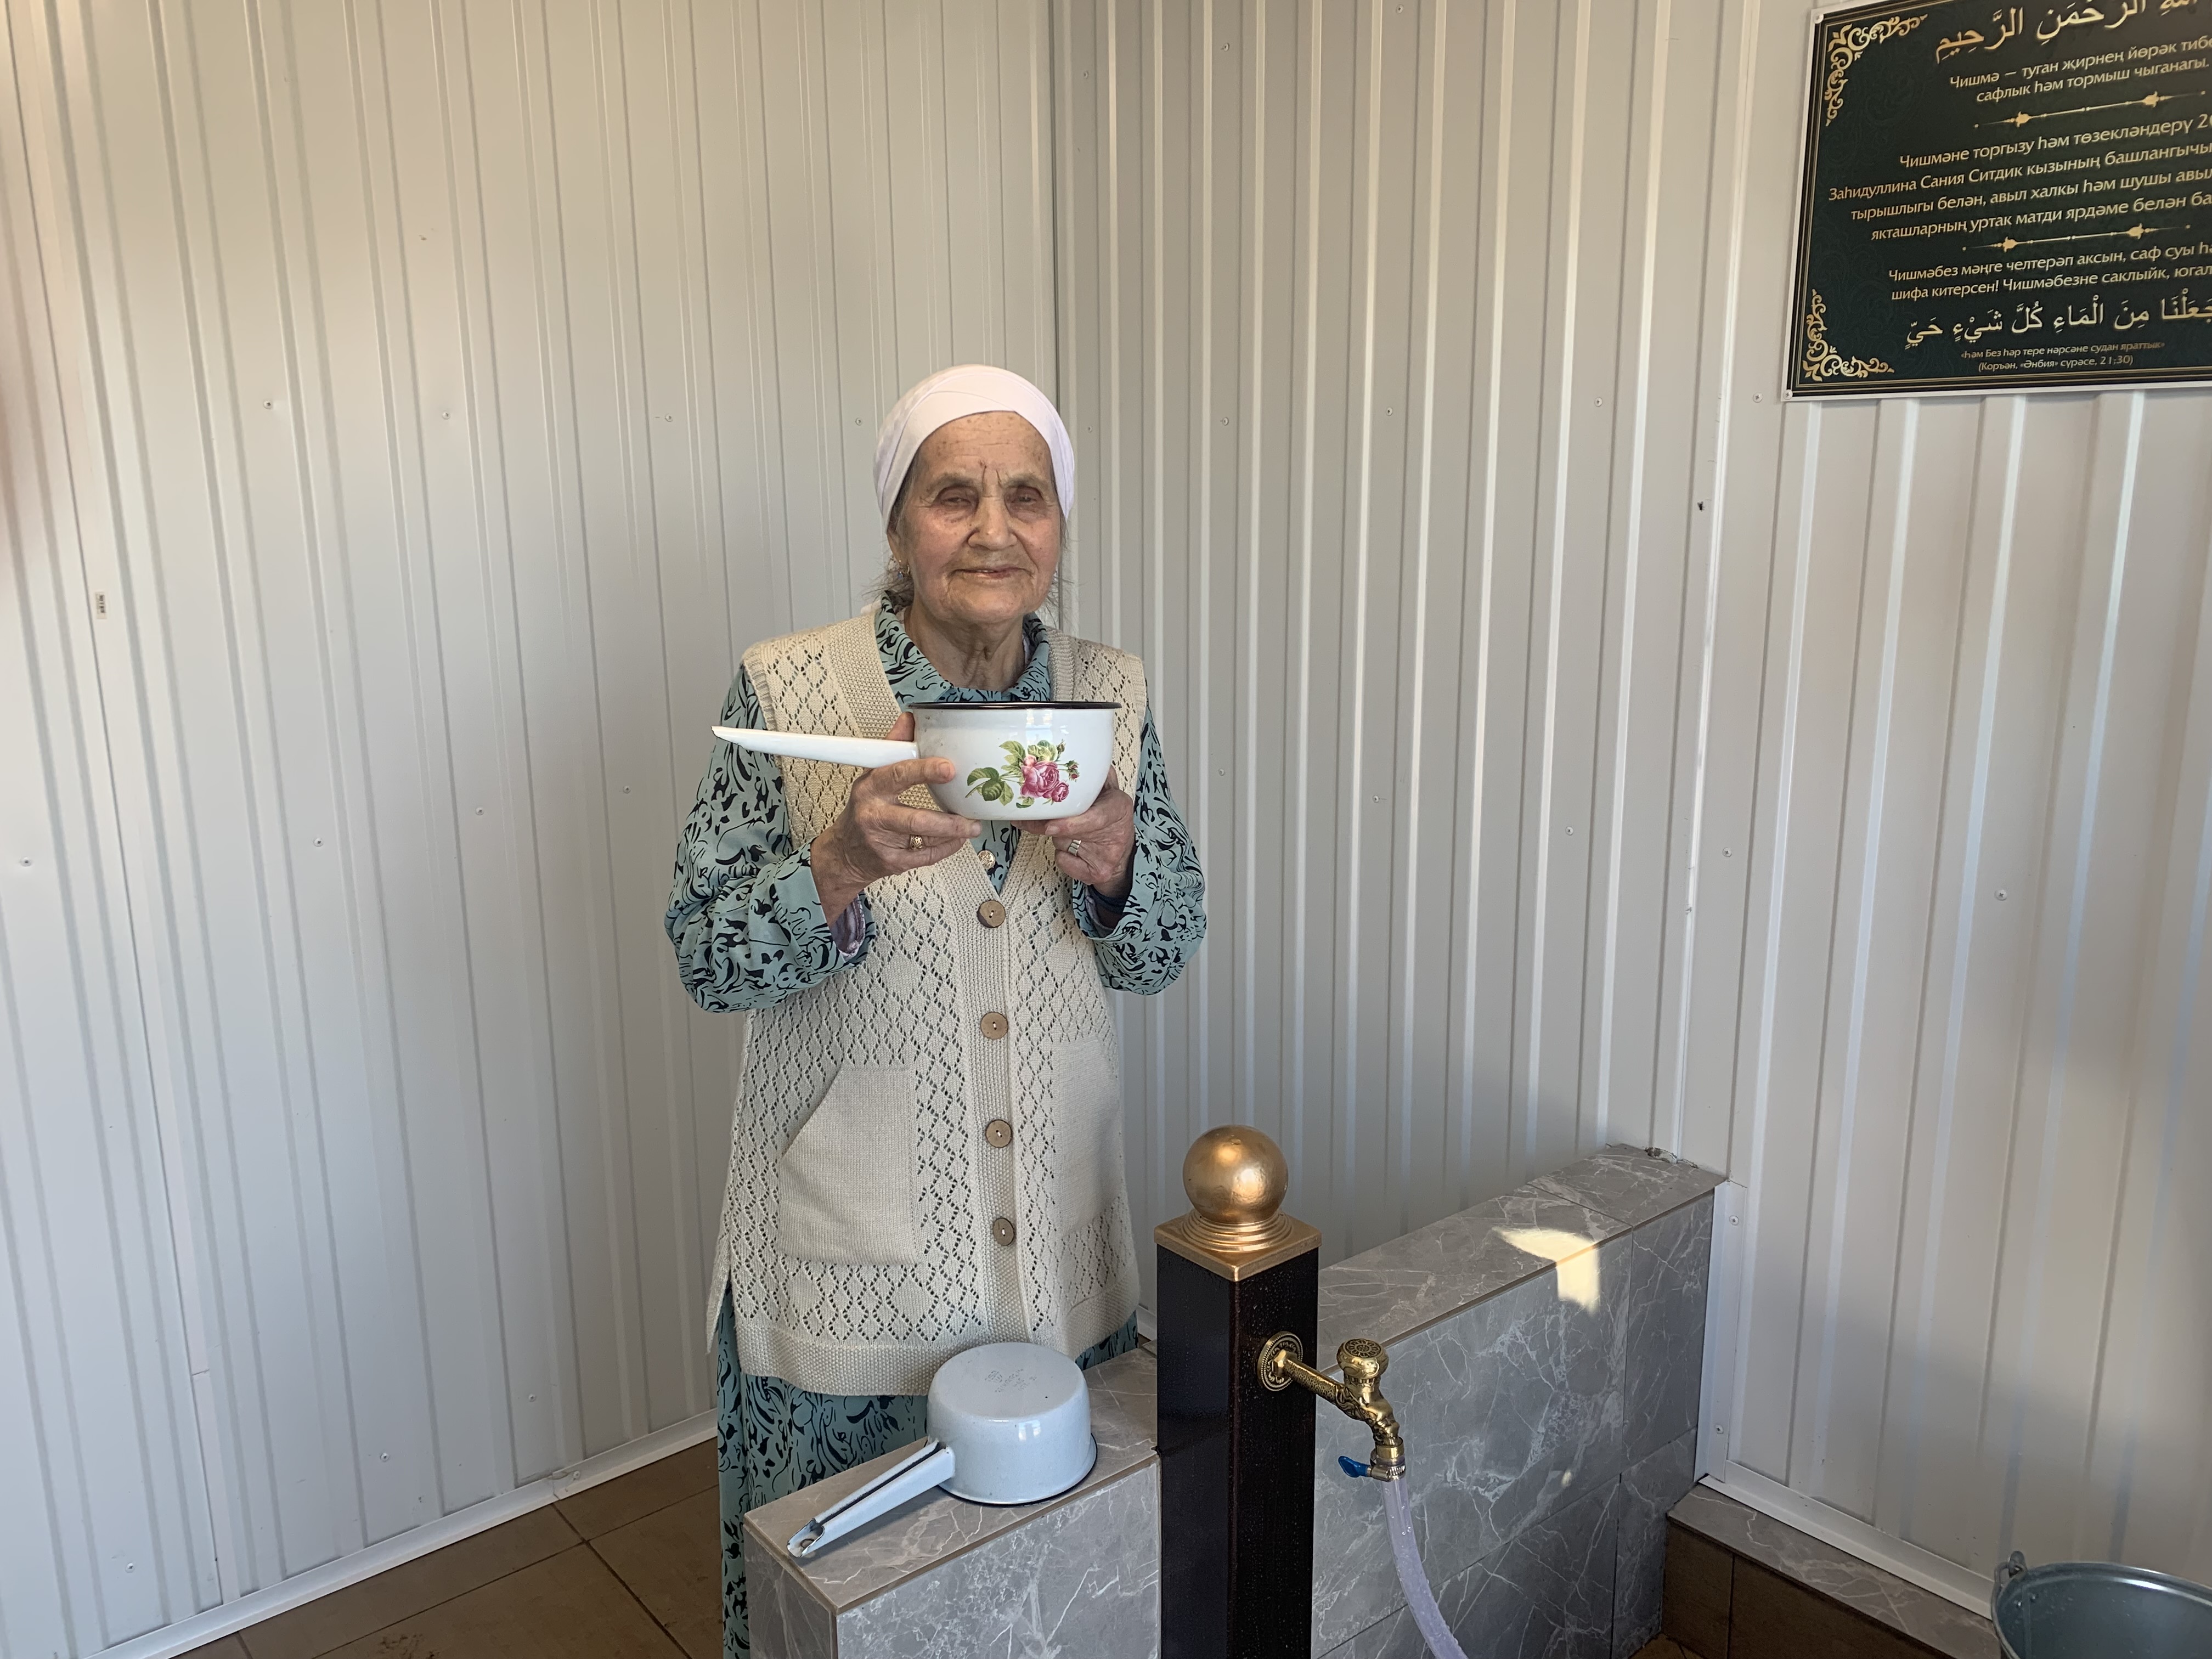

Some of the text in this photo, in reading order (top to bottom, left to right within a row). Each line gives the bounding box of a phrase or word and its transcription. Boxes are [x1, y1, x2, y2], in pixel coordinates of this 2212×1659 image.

[1950, 72, 2000, 88] Чишмә
[2022, 61, 2058, 80] туган
[2062, 51, 2124, 71] җирнең
[2128, 43, 2177, 60] йөрәк
[1977, 58, 2209, 103] сафлык һәм тормыш чыганагы.
[1900, 150, 1970, 168] Чишмәне
[1973, 140, 2035, 161] торгызу
[2038, 136, 2070, 150] һәм
[2074, 119, 2194, 144] төзекләндерү
[1829, 142, 2212, 201] Заһидуллина Сания Ситдик кызының башлангычы
[1851, 201, 1934, 222] тырышлыгы
[1938, 195, 1987, 210] белән,
[1990, 190, 2027, 204] авыл
[2030, 184, 2079, 199] халкы
[2083, 179, 2115, 193] һәм
[2120, 172, 2172, 190] шушы
[1871, 221, 1967, 240] якташларның
[1969, 215, 2012, 232] уртак
[2016, 210, 2062, 224] матди
[2066, 202, 2129, 222] ярдәме
[2133, 196, 2187, 212] белән
[1889, 265, 1958, 281] Чишмәбез
[1961, 263, 2003, 275] мәңге
[2006, 256, 2073, 271] челтерәп
[2077, 252, 2126, 266] аксын,
[2131, 246, 2162, 261] саф
[2165, 245, 2195, 259] суы
[1892, 287, 1928, 301] шифа
[1932, 280, 1999, 297] китерсен!
[2003, 274, 2098, 291] Чишмәбезне
[2102, 267, 2170, 283] саклыйк,
[1978, 362, 2018, 373] (Коръән,
[2060, 358, 2097, 368] сүрәсе,
[1985, 349, 2001, 357] Без
[2003, 348, 2021, 358] һәр
[2023, 348, 2045, 357] тере
[2047, 346, 2089, 356] нәрсәне
[2091, 344, 2119, 354] судан
